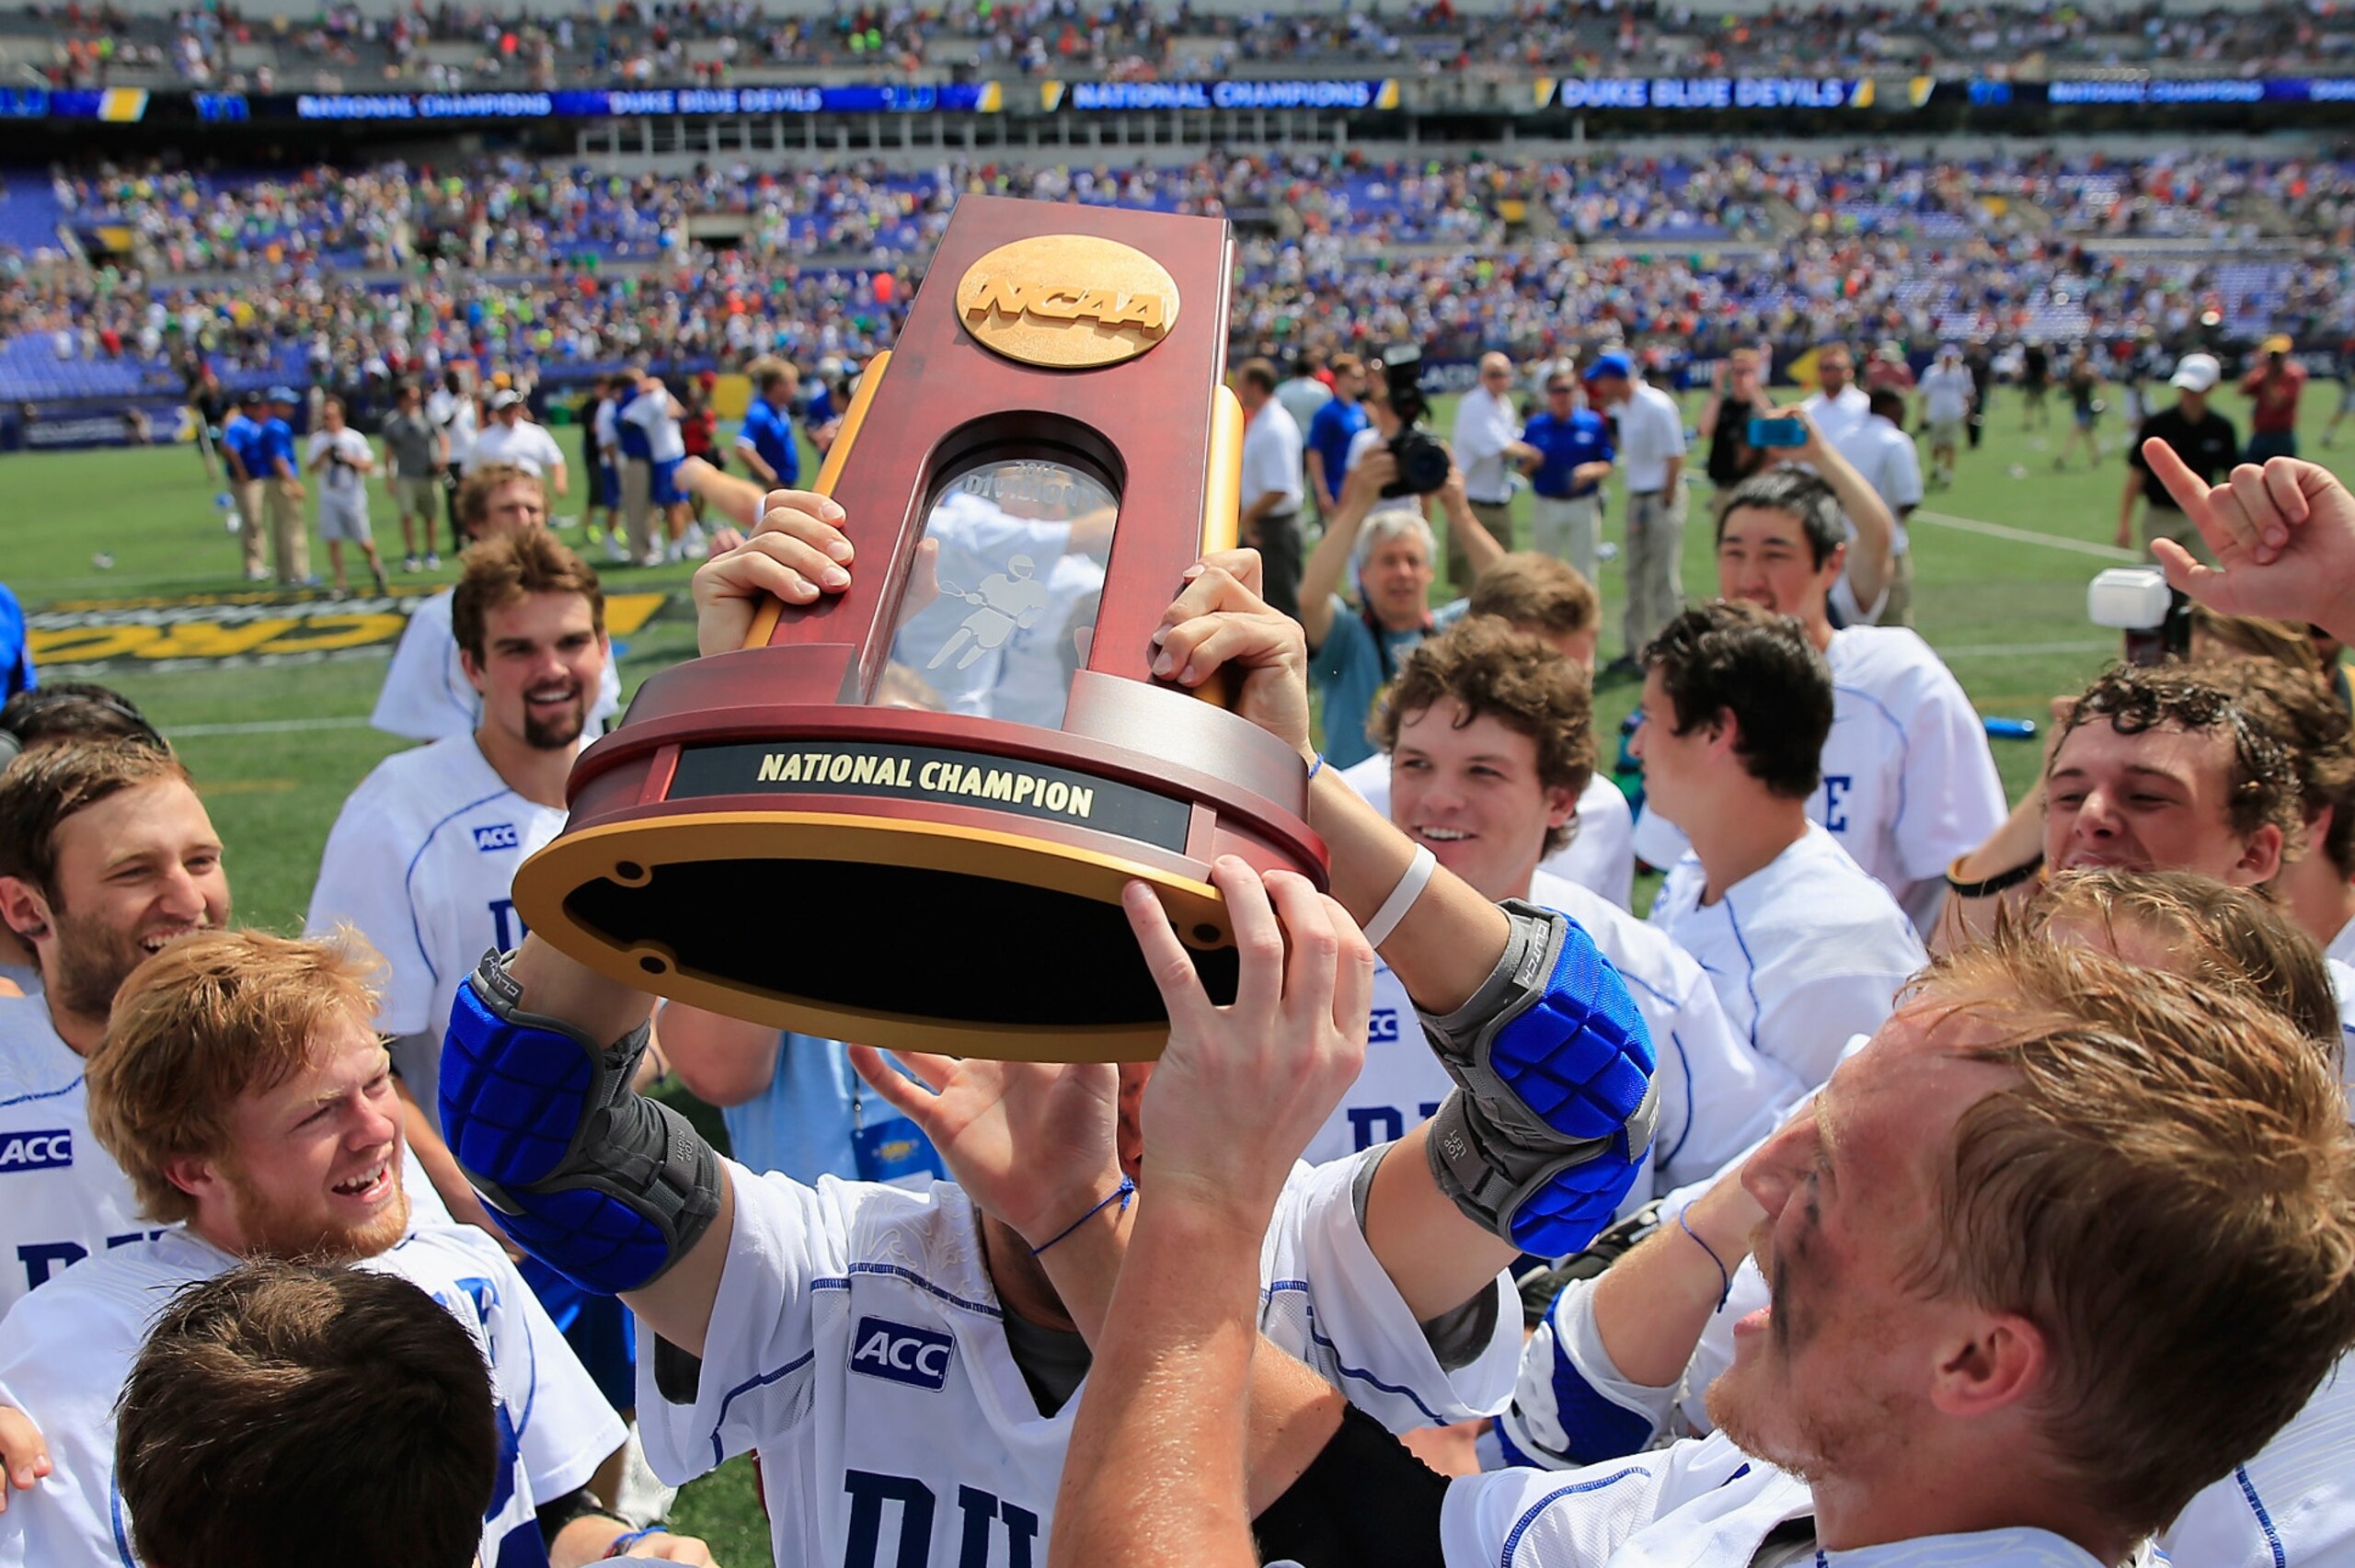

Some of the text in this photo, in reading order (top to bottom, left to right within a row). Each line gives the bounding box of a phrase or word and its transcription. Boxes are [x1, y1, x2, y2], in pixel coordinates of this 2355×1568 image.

[297, 93, 551, 119] NATIONAL CHAMPIONS
[609, 88, 821, 115] DUKE BLUE DEVILS
[1073, 80, 1370, 109] NATIONAL CHAMPIONS
[1564, 77, 1844, 108] DUKE BLUE DEVILS
[967, 279, 1165, 338] NCAA
[758, 753, 1094, 818] NATIONAL CHAMPION
[478, 827, 517, 848] ACC
[1522, 922, 1548, 986] CLUTCH
[0, 1135, 72, 1165] ACC
[677, 1128, 686, 1162] RIGHT
[1443, 1139, 1460, 1162] TOP
[1450, 1128, 1467, 1157] LEFT
[855, 1330, 951, 1379] ACC
[844, 1468, 1040, 1568] DU
